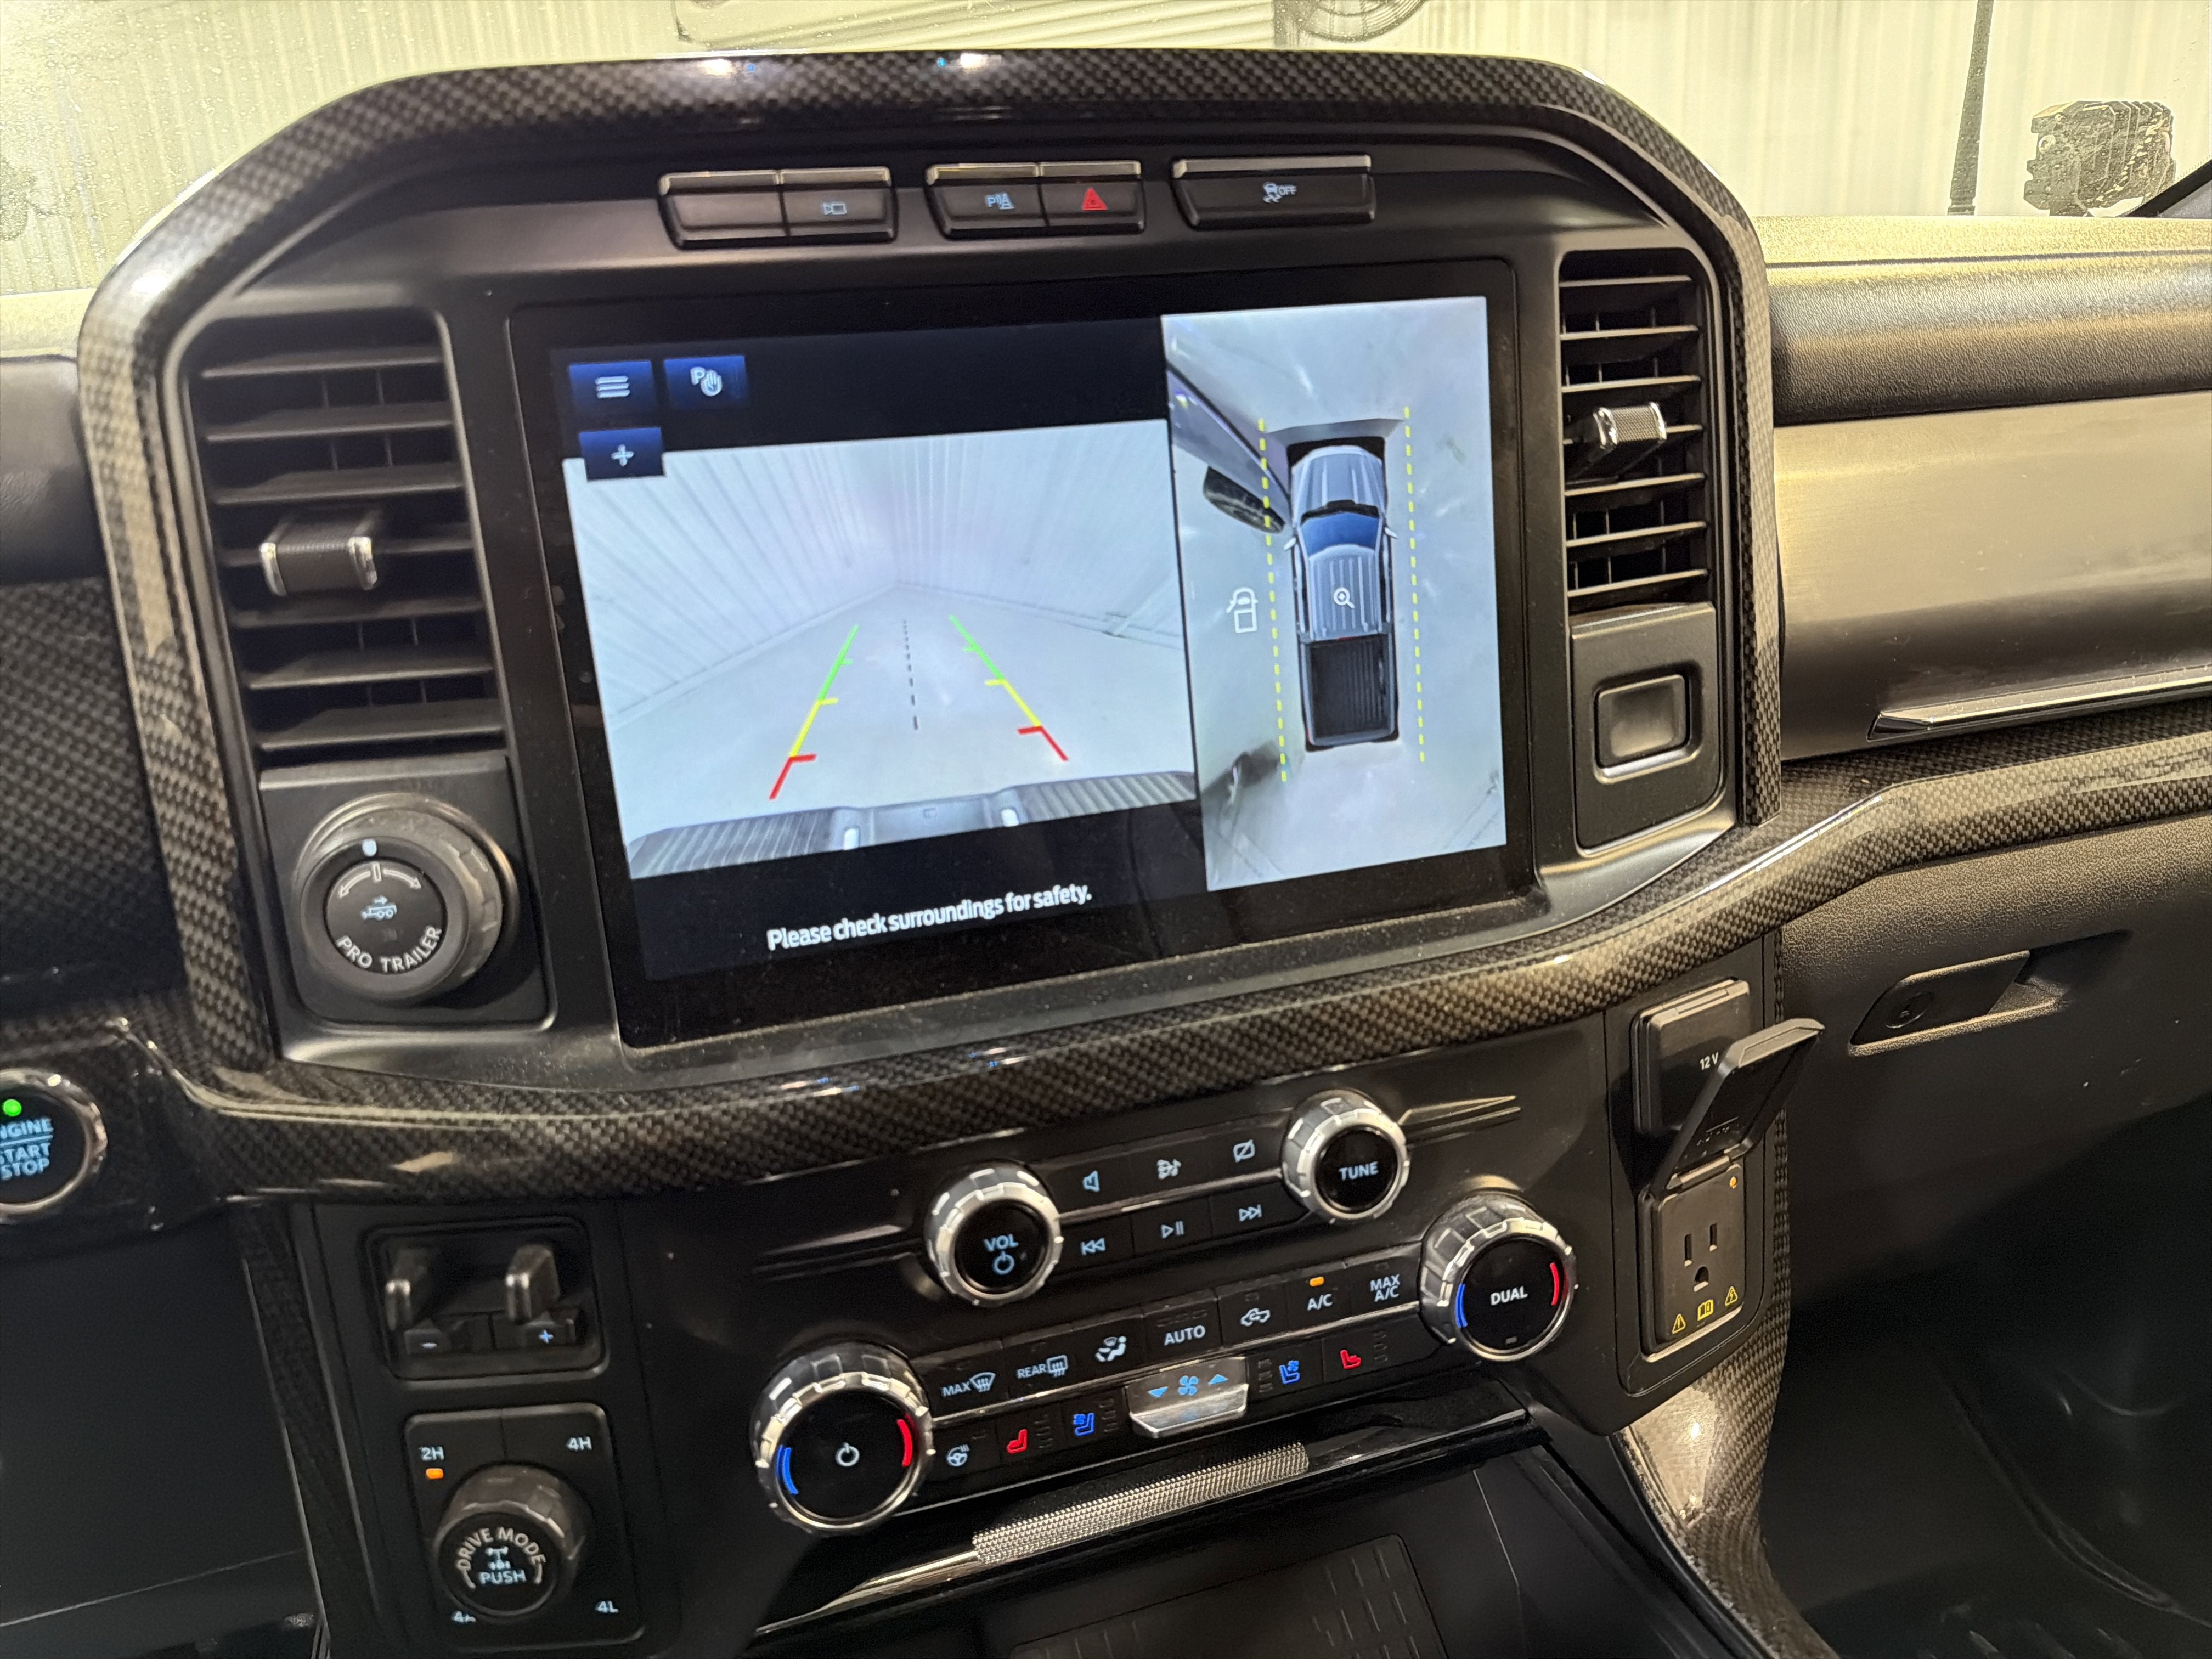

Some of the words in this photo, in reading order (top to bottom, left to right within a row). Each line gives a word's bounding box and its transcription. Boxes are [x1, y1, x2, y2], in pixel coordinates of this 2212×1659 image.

[1279, 185, 1297, 195] OFF
[767, 927, 832, 950] Please
[833, 913, 888, 940] check
[888, 900, 1005, 932] surroundings
[1005, 891, 1032, 913] for
[1033, 883, 1092, 907] safety.
[336, 935, 373, 969] PRO
[380, 926, 442, 973] TRAILER
[1700, 1055, 1711, 1071] 12
[1712, 1052, 1719, 1065] V
[0, 1118, 54, 1139] NGINE
[0, 1158, 50, 1181] STOP
[1338, 1161, 1379, 1181] TUNE
[984, 1234, 1019, 1252] VOL
[1370, 1274, 1401, 1291] MAX
[1307, 1293, 1333, 1311] A/C
[1374, 1285, 1400, 1302] A/C
[1491, 1286, 1528, 1306] DUAL
[1163, 1325, 1206, 1346] AUTO
[1017, 1363, 1047, 1379] REAR
[941, 1381, 971, 1397] MAX
[566, 1436, 592, 1452] 4H
[420, 1446, 444, 1462] 2H
[456, 1527, 494, 1572] DRIVE
[497, 1526, 546, 1565] MODE
[478, 1568, 527, 1586] PUSH
[596, 1600, 619, 1614] 4L
